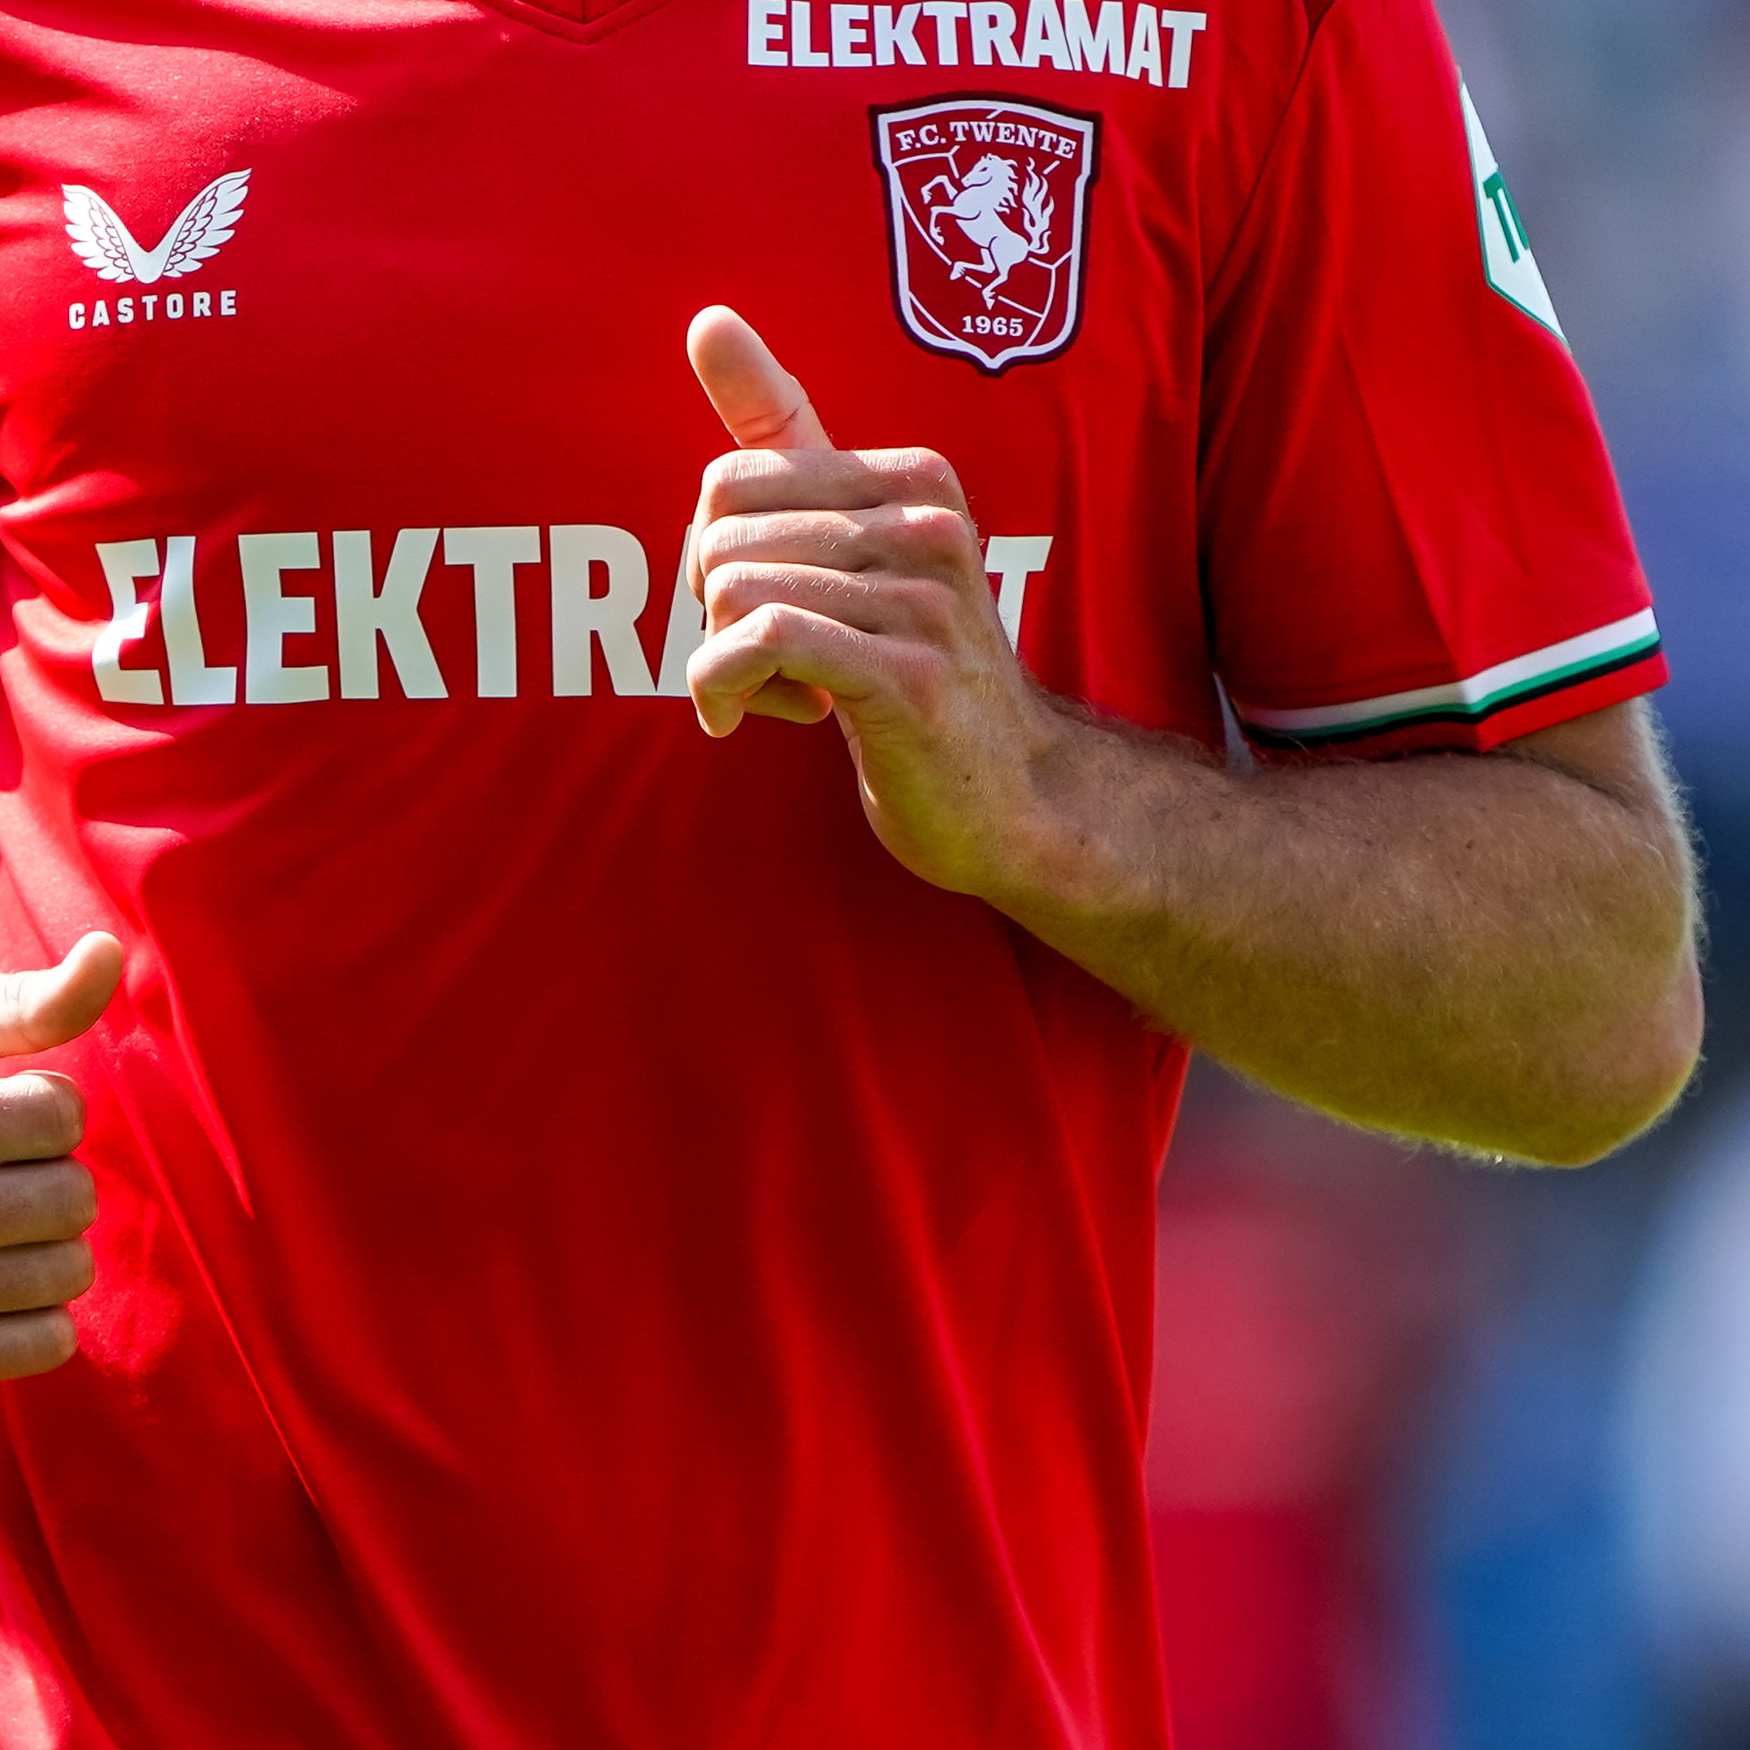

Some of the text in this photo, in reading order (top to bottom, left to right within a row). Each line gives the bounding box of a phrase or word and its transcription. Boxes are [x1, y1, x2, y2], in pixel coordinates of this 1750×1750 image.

[894, 120, 1077, 159] F.C. TWENTE
[68, 289, 237, 330] CASTORE
[961, 315, 1024, 337] 1965
